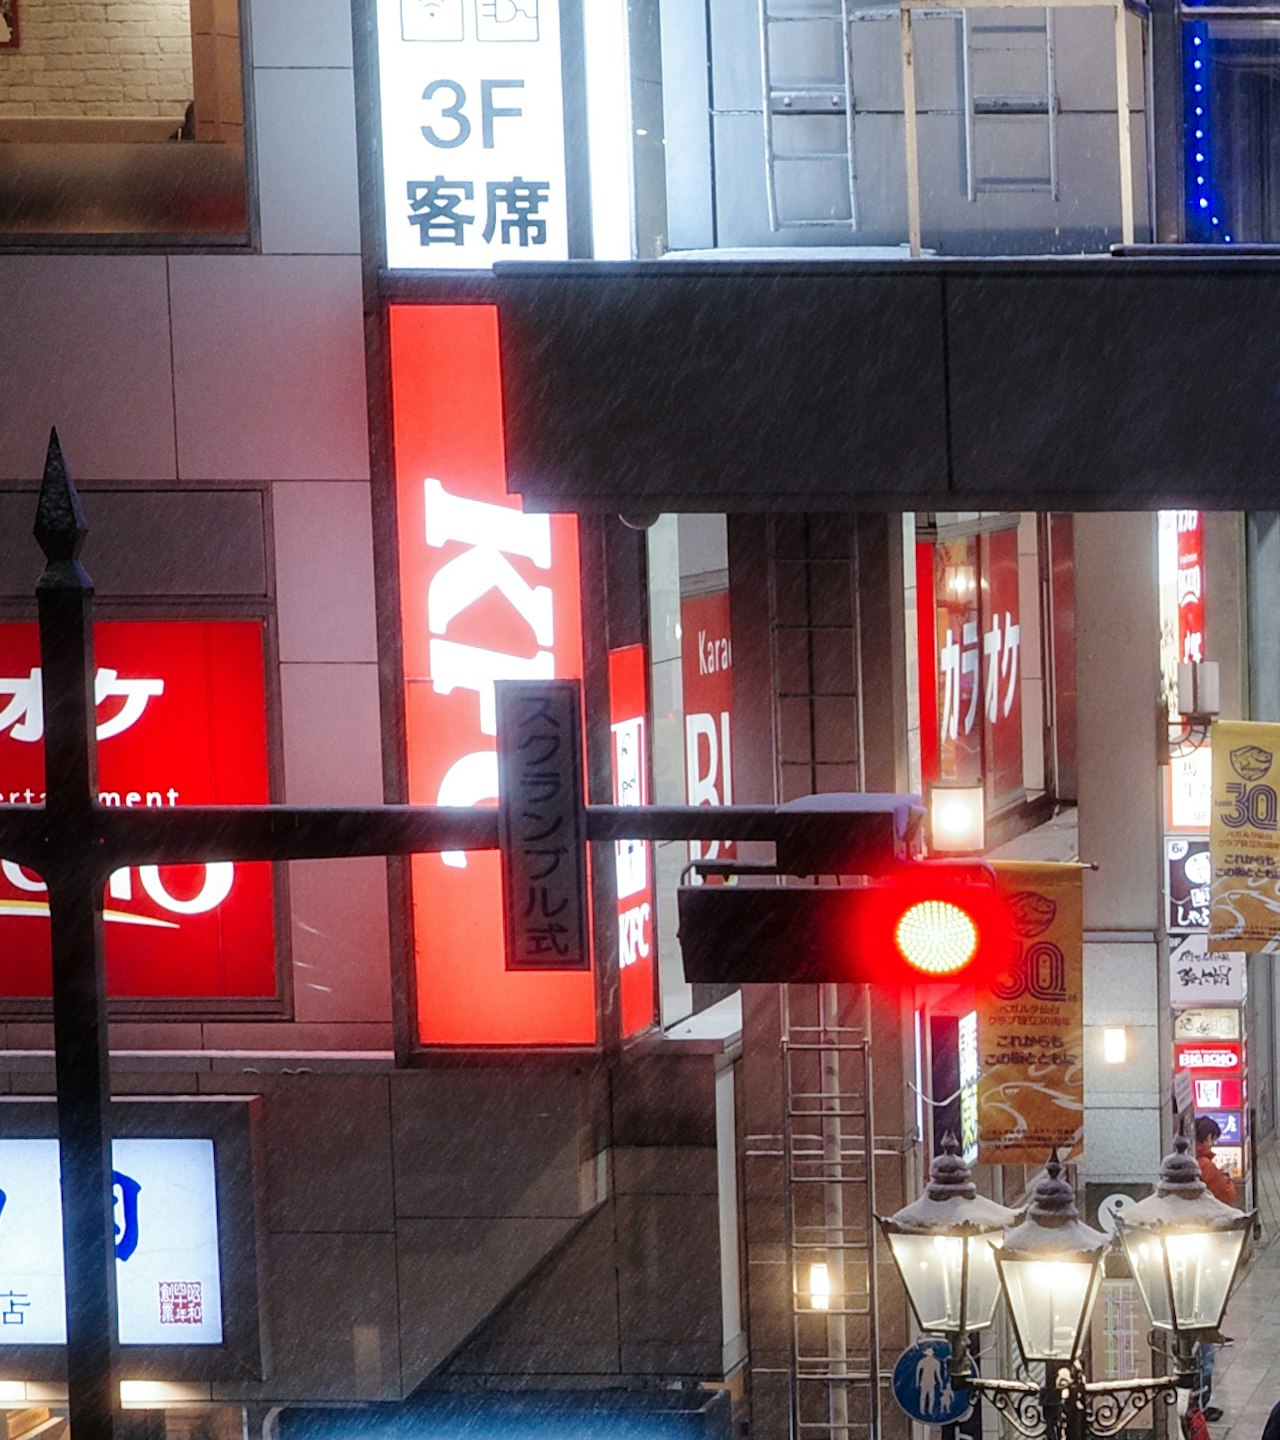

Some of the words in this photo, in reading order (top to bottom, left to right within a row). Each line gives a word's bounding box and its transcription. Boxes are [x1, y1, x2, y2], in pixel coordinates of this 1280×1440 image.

[420, 78, 526, 150] 3F
[405, 175, 551, 248] 客席
[698, 629, 733, 677] Kara
[940, 610, 1021, 744] カラオケ
[1220, 782, 1280, 832] 30
[1224, 853, 1276, 866] これからも
[617, 902, 650, 969] KFC
[995, 1034, 1066, 1049] これからも
